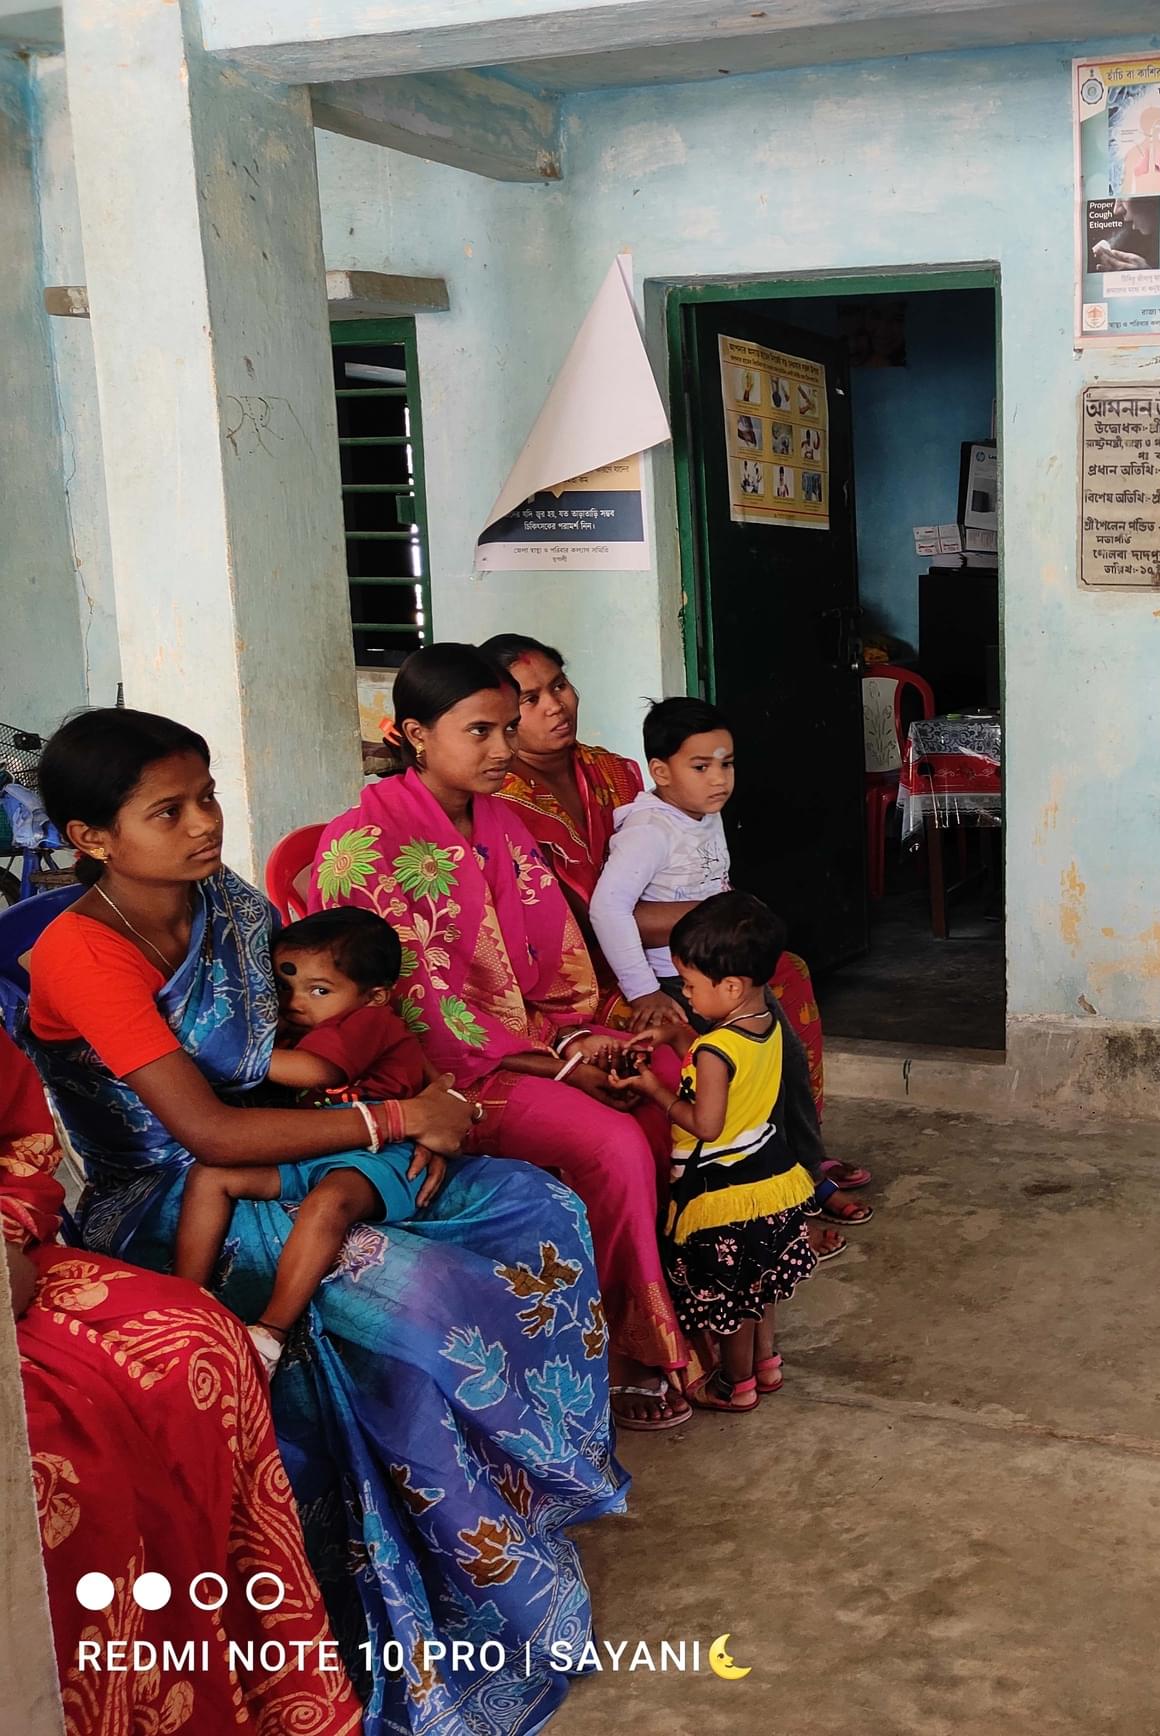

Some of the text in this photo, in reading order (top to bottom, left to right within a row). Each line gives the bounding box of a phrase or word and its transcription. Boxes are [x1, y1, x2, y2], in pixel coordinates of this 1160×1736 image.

[1126, 70, 1135, 79] বা
[1090, 202, 1113, 210] Proper
[1089, 210, 1113, 220] Cough
[1090, 220, 1123, 230] Etiquette
[1088, 464, 1117, 476] প্রধান
[1085, 489, 1114, 504] বিশেষ
